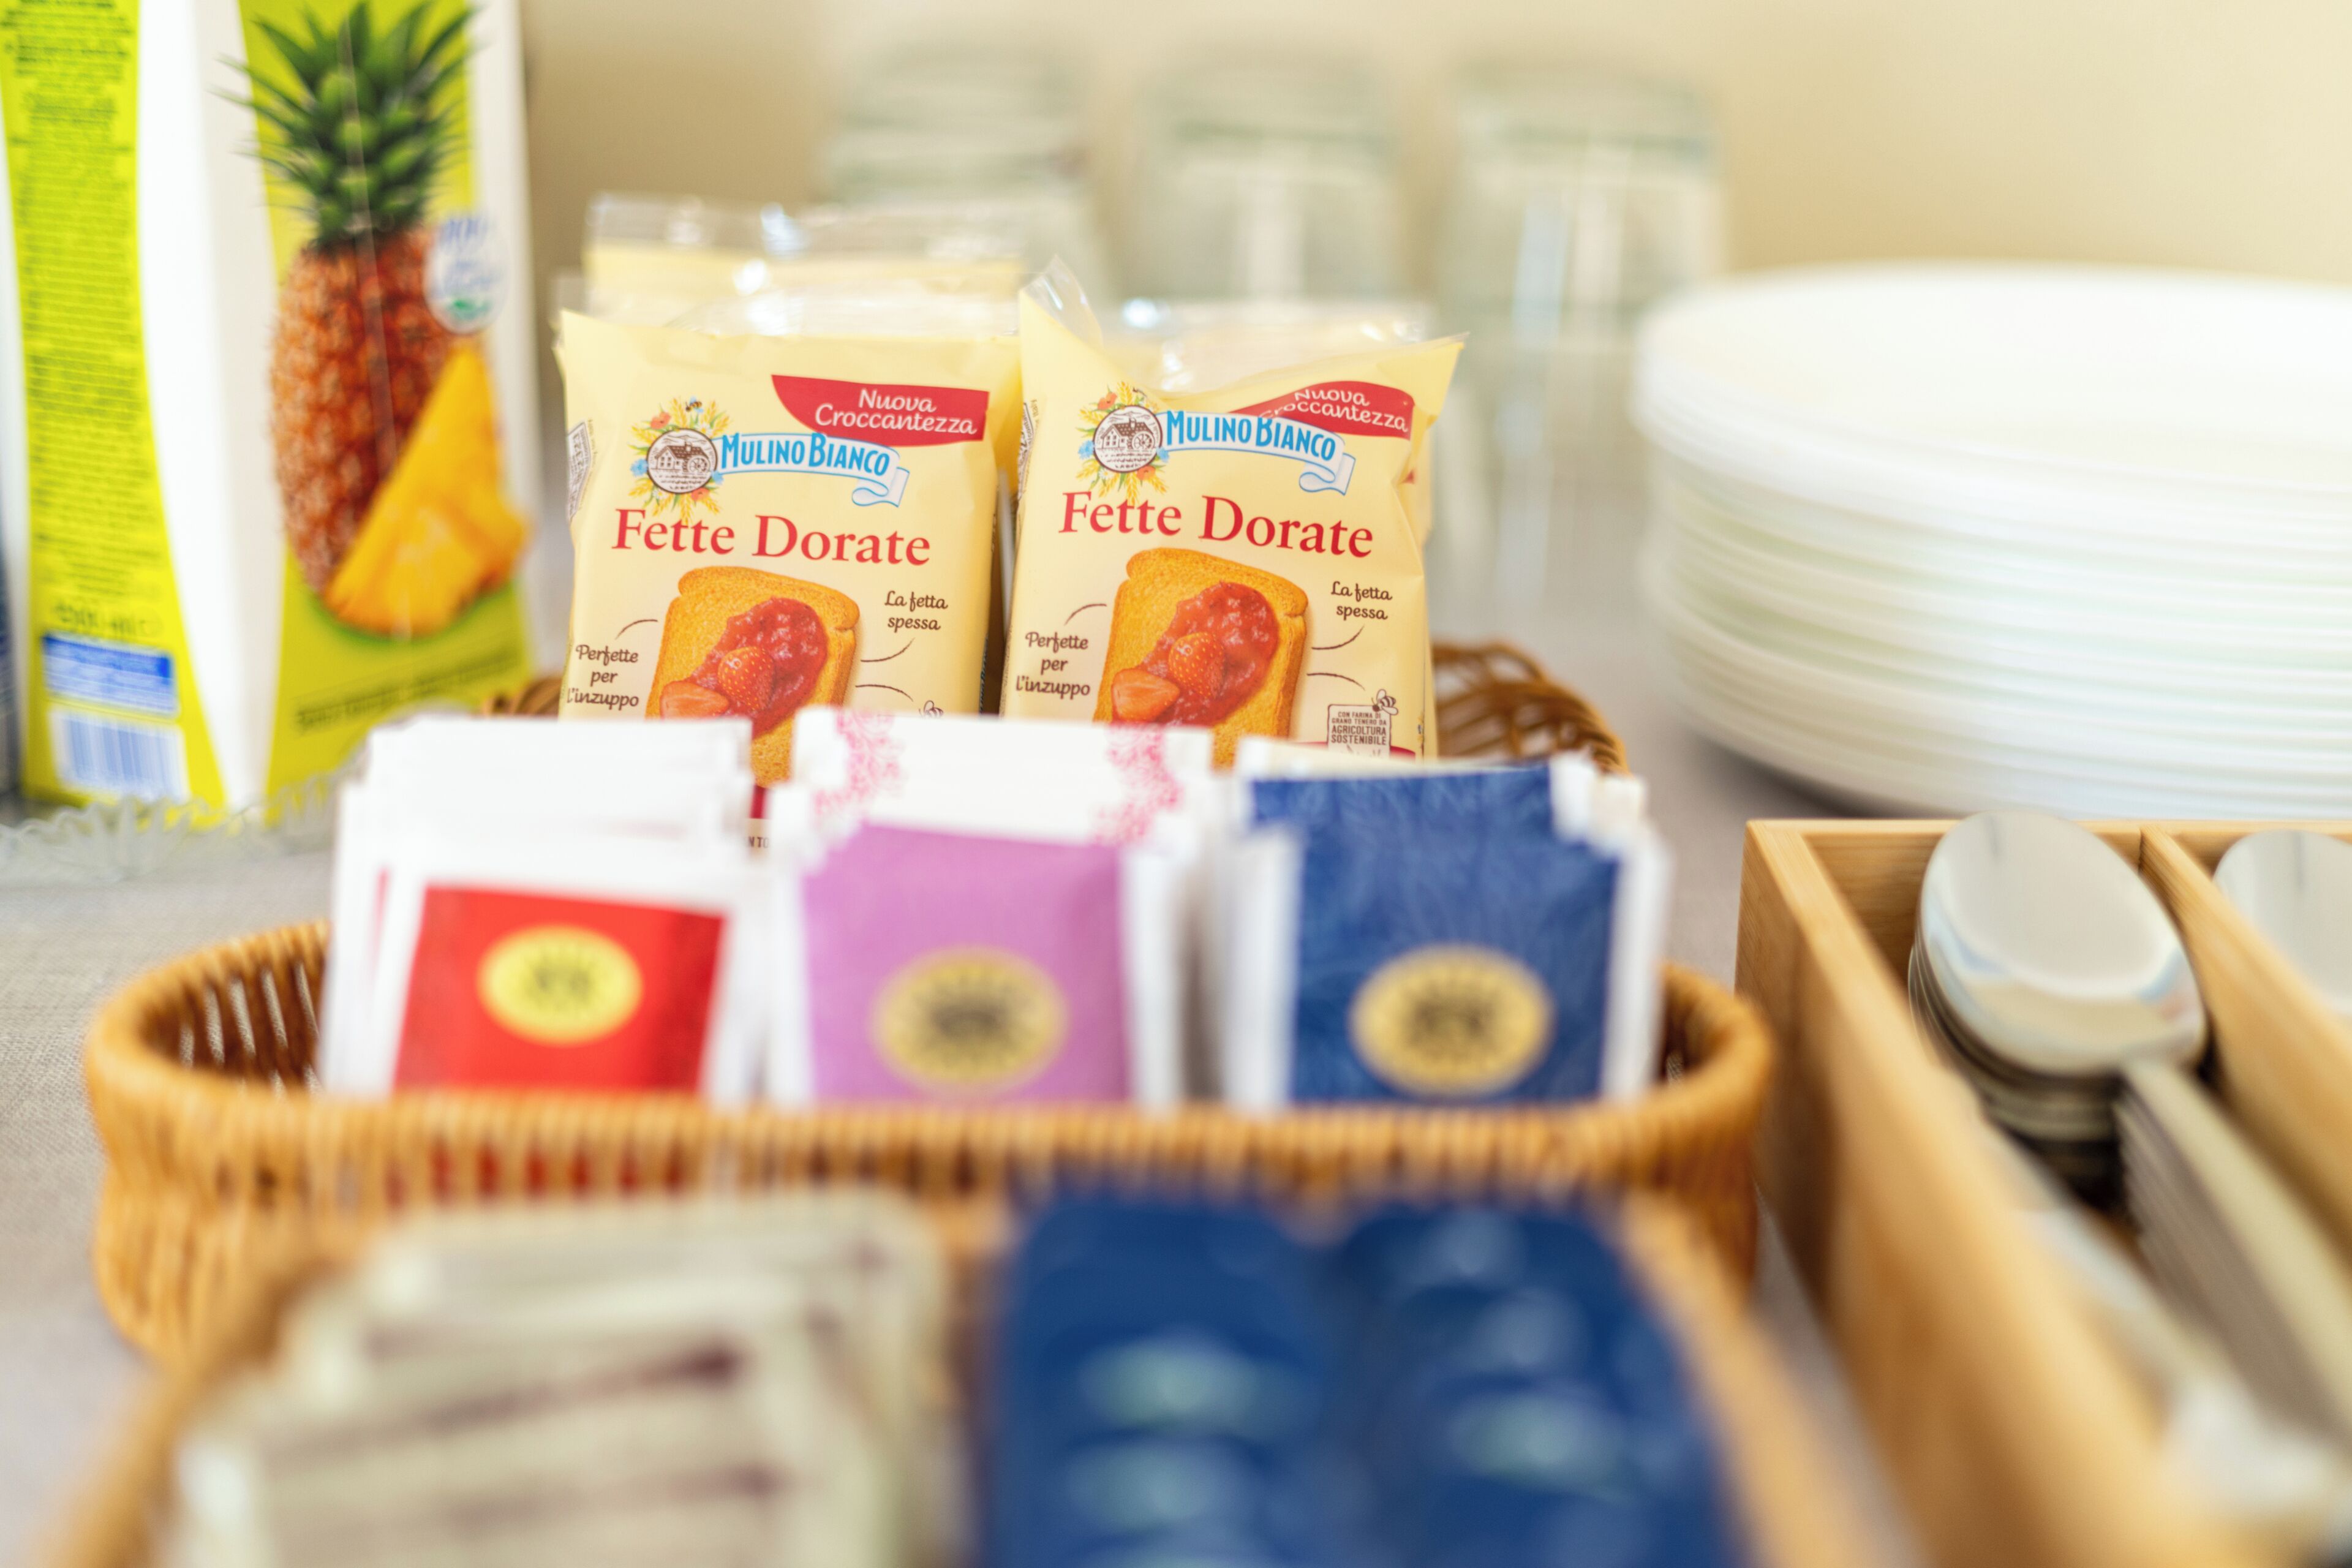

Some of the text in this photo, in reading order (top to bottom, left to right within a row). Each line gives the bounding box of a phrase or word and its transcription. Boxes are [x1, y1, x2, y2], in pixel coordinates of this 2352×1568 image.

[858, 388, 937, 413] Nuova
[1294, 388, 1371, 407] Nuova
[815, 403, 978, 435] Croccantezza
[1259, 401, 1409, 433] Croccantezza
[1167, 410, 1336, 461] MULINO BIANCO
[722, 432, 890, 477] MULINO BIANCO
[1058, 491, 1182, 536] Fette
[1198, 495, 1374, 558] Dorate
[611, 508, 930, 566] Fette Dorate
[884, 590, 949, 612] La fetta
[1330, 581, 1393, 602] La fetta
[1336, 605, 1389, 621] spessa
[888, 617, 941, 633] spessa
[1025, 631, 1089, 654] Perfette
[575, 644, 639, 666] Perfette
[1040, 658, 1068, 676] per
[589, 671, 619, 687] per
[1016, 675, 1091, 700] l'inzuppo
[567, 687, 639, 711] l'inzuppo
[1331, 734, 1387, 745] SOSTENIBILE
[1332, 725, 1387, 736] AGRICOLTURA
